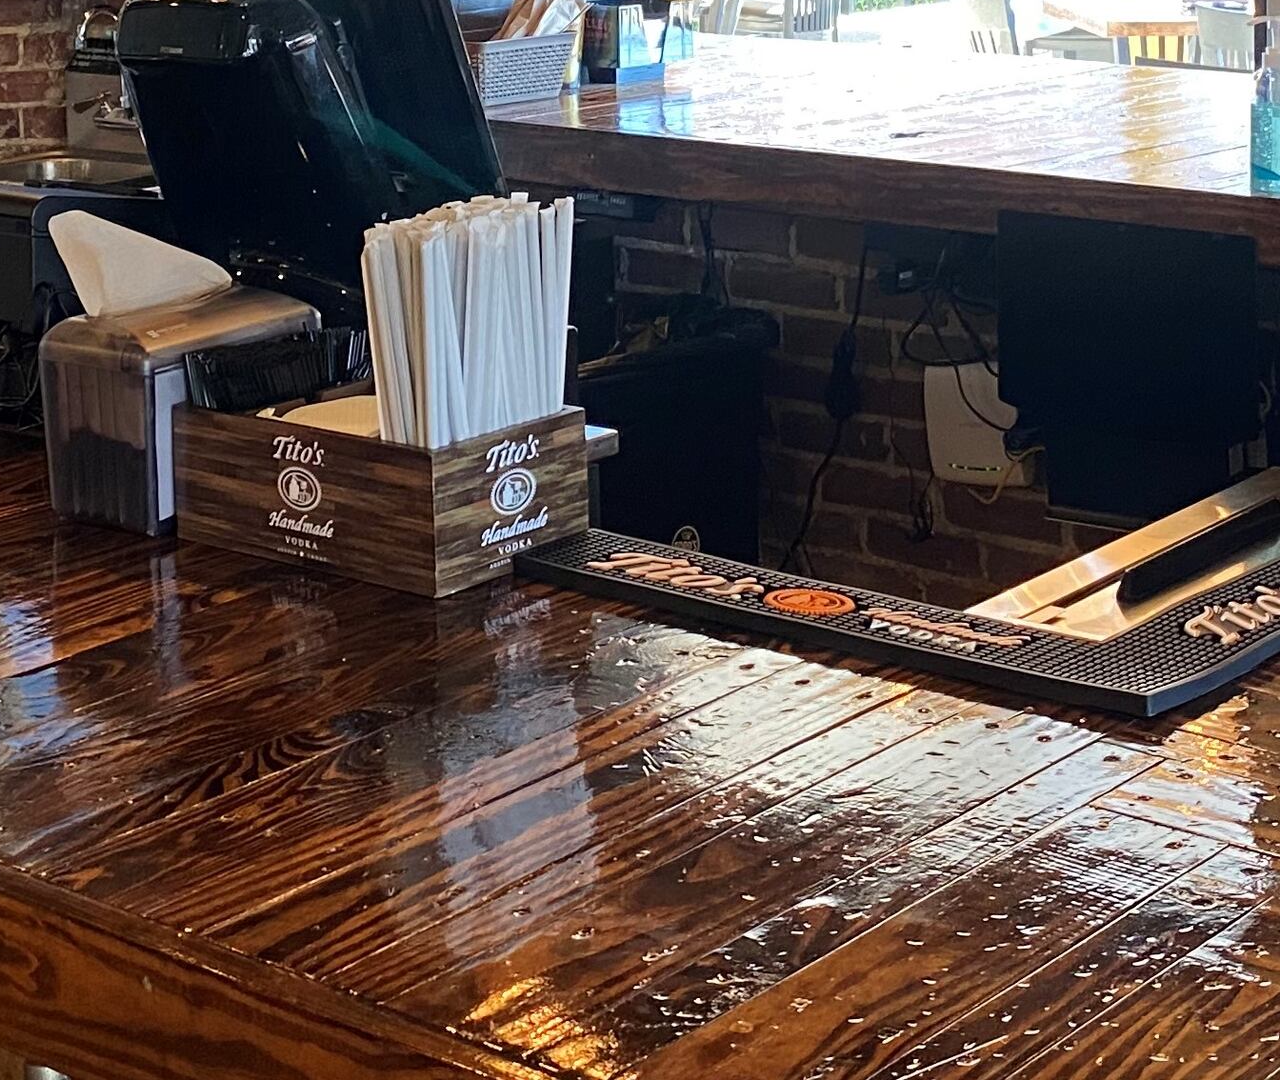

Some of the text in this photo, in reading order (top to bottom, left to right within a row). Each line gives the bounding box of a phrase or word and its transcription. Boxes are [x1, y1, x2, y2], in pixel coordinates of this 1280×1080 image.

[268, 509, 335, 539] Handmade
[480, 505, 549, 548] Handmade
[284, 534, 319, 551] VODKA
[497, 537, 533, 556] VODKA
